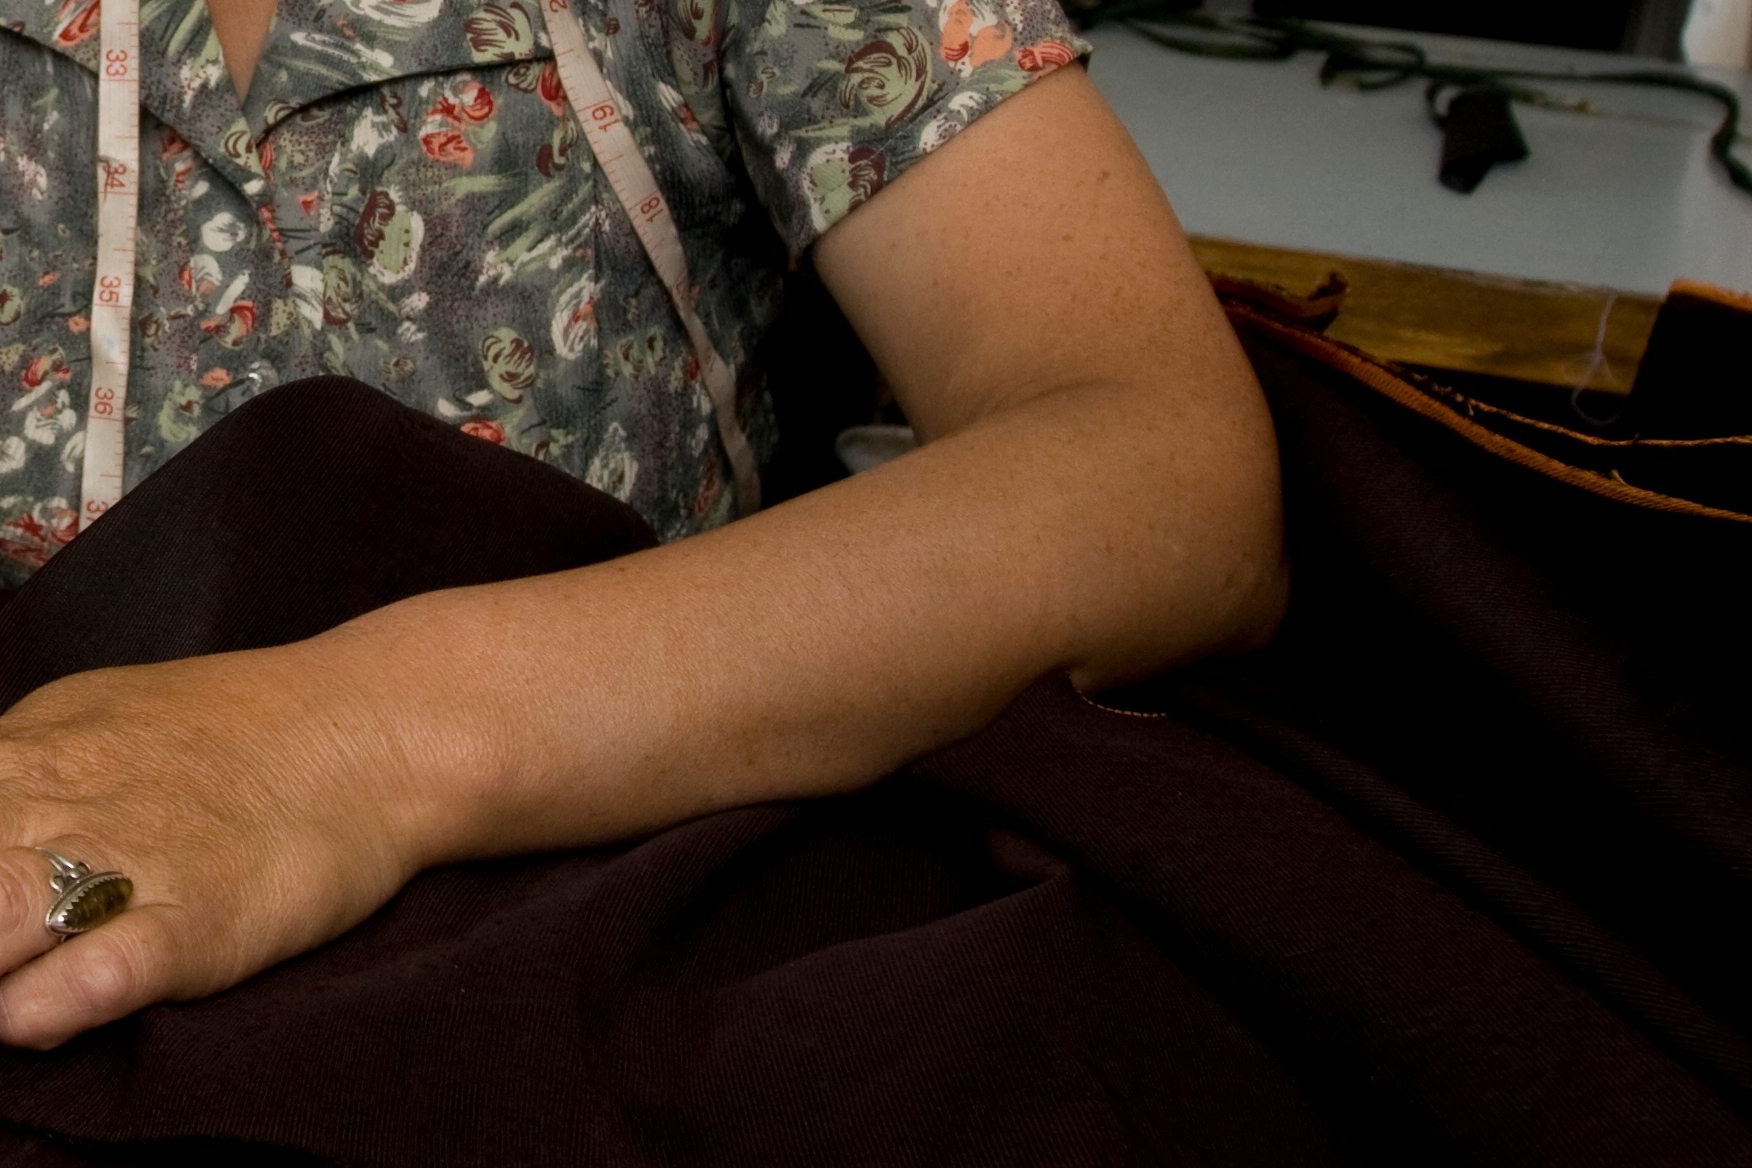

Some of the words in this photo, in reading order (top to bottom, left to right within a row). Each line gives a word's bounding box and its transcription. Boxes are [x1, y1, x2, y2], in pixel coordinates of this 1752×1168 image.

[105, 48, 128, 77] 33
[592, 104, 620, 132] 19
[98, 275, 122, 304] 35
[94, 386, 115, 416] 36
